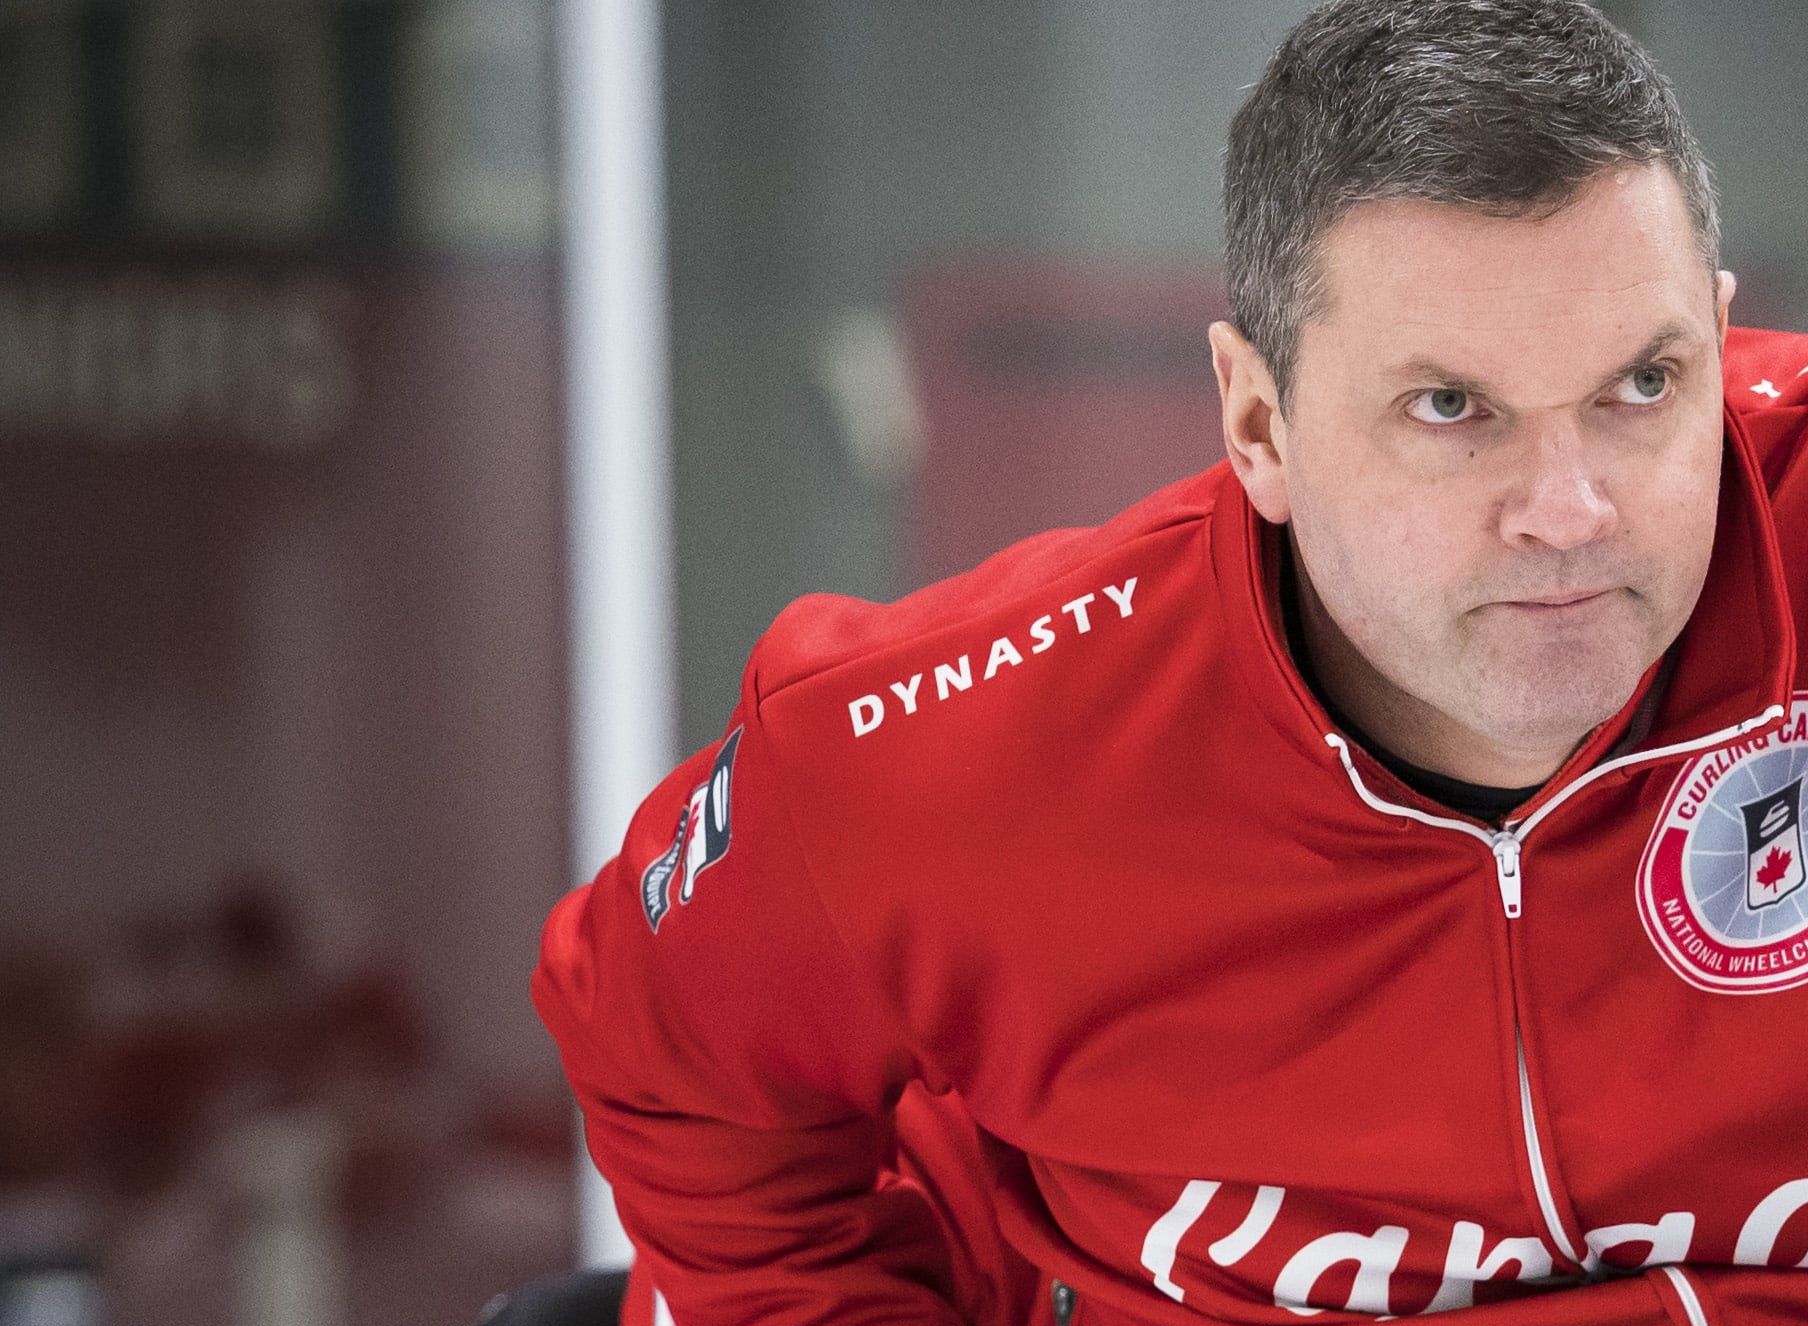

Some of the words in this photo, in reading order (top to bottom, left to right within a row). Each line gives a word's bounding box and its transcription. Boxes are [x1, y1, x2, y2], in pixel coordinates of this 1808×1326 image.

[847, 577, 1140, 738] DYNASTY
[1677, 735, 1770, 820] CURLING
[1663, 898, 1724, 972] NATIONAL
